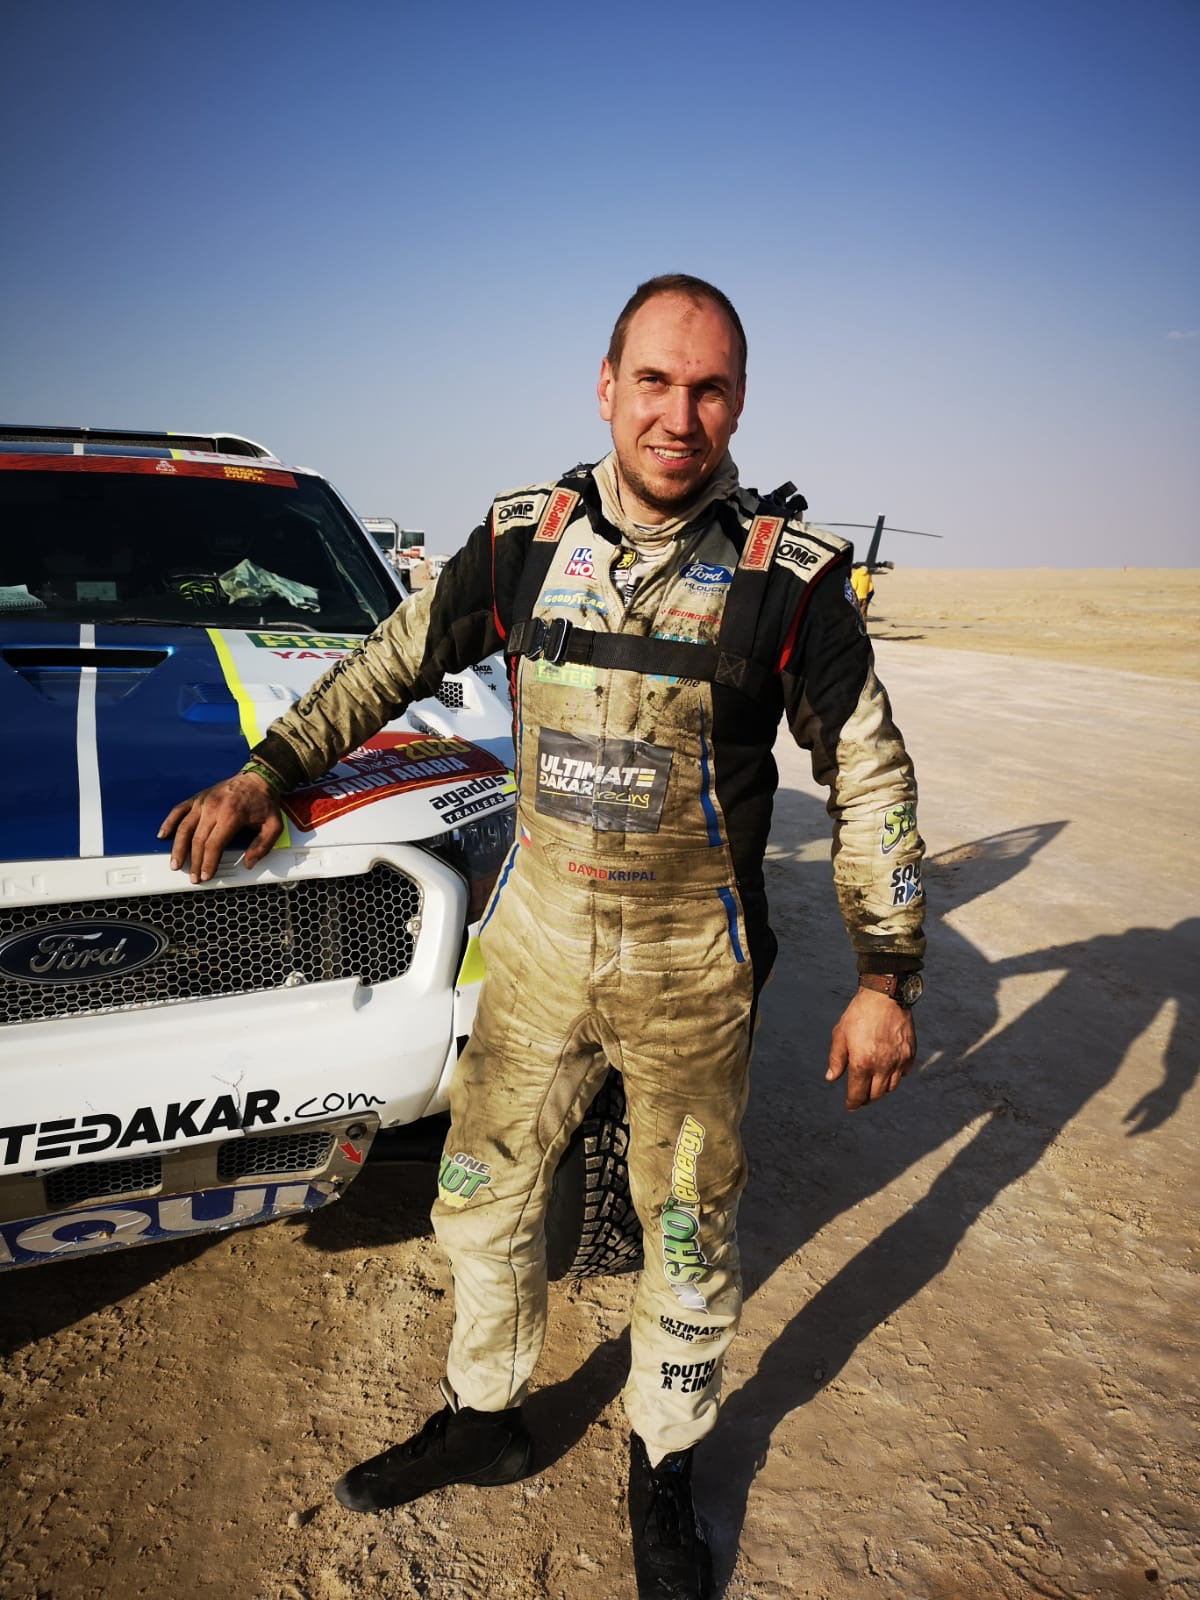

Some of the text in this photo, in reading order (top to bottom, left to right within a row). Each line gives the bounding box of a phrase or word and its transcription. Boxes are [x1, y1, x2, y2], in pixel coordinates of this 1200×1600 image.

[498, 502, 534, 520] OMP
[541, 494, 571, 537] SIMPSON
[749, 518, 775, 567] SIMPSON
[778, 543, 818, 568] OMP
[686, 563, 723, 582] Ford
[544, 593, 606, 609] GOODYEAR
[393, 738, 472, 761] 2020
[321, 772, 397, 800] SAUDI
[391, 756, 470, 781] ARABIA
[540, 752, 657, 787] ULTIMATE
[429, 774, 508, 809] agados
[539, 772, 650, 805] DAKAR racing
[446, 794, 504, 823] TRAILERS
[29, 930, 126, 975] Ford
[455, 1154, 490, 1174] ONE
[673, 1117, 704, 1202] energy
[660, 1358, 716, 1378] SOUTH
